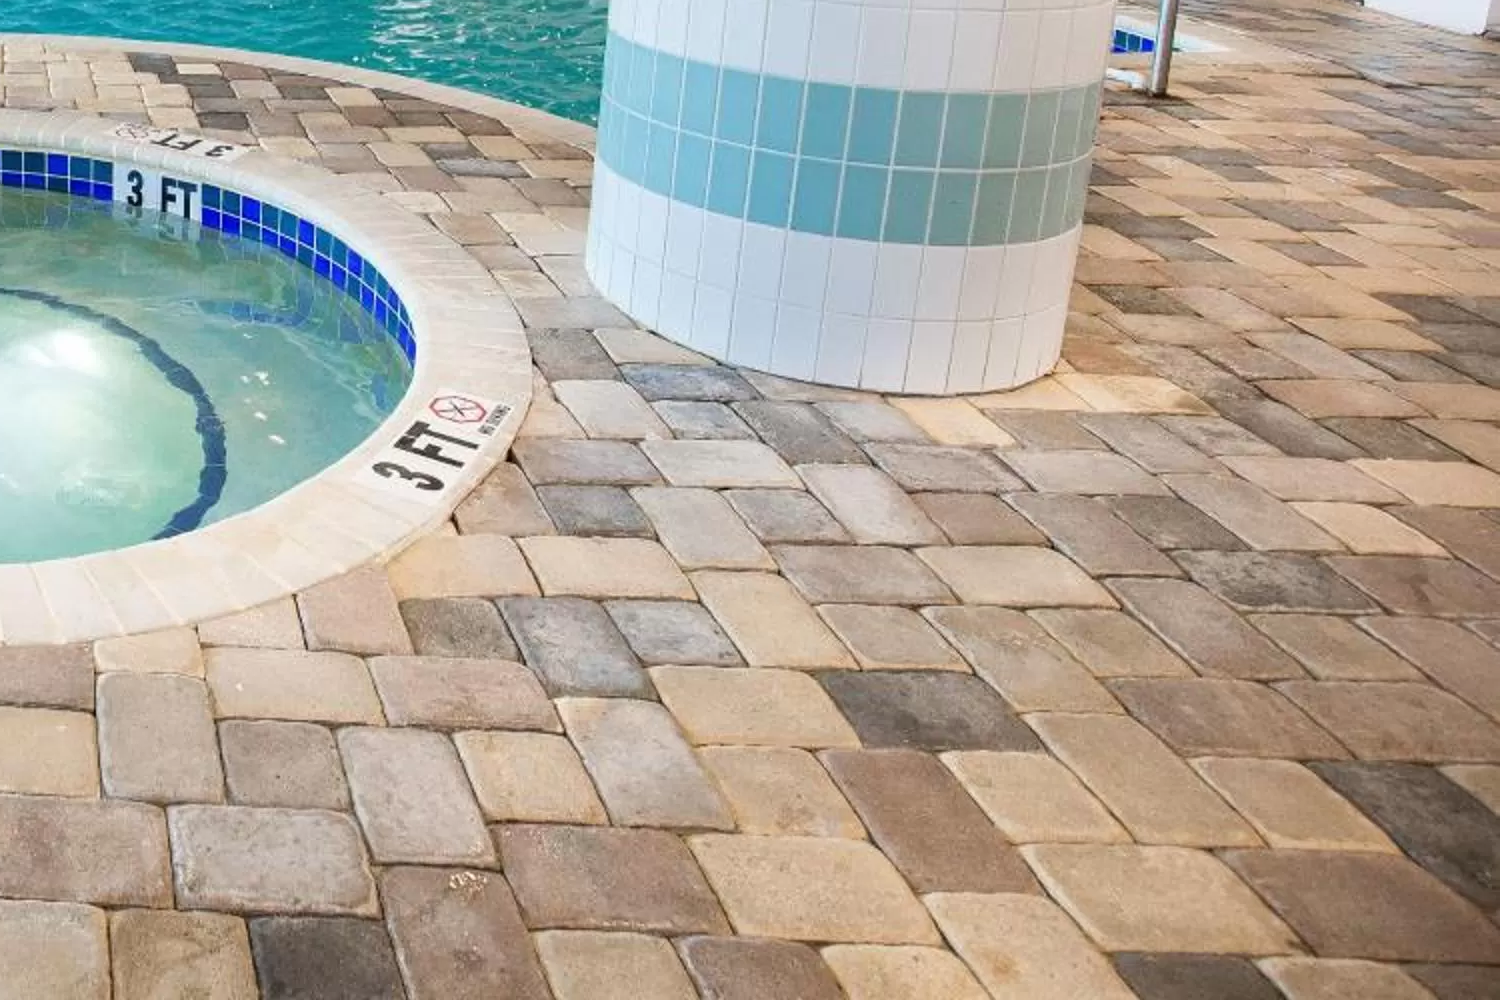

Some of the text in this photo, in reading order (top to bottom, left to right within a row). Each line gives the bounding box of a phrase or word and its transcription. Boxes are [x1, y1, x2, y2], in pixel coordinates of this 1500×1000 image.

[151, 133, 233, 157] 3 FT
[126, 169, 197, 220] 3 FT
[371, 420, 480, 491] 3 FT
